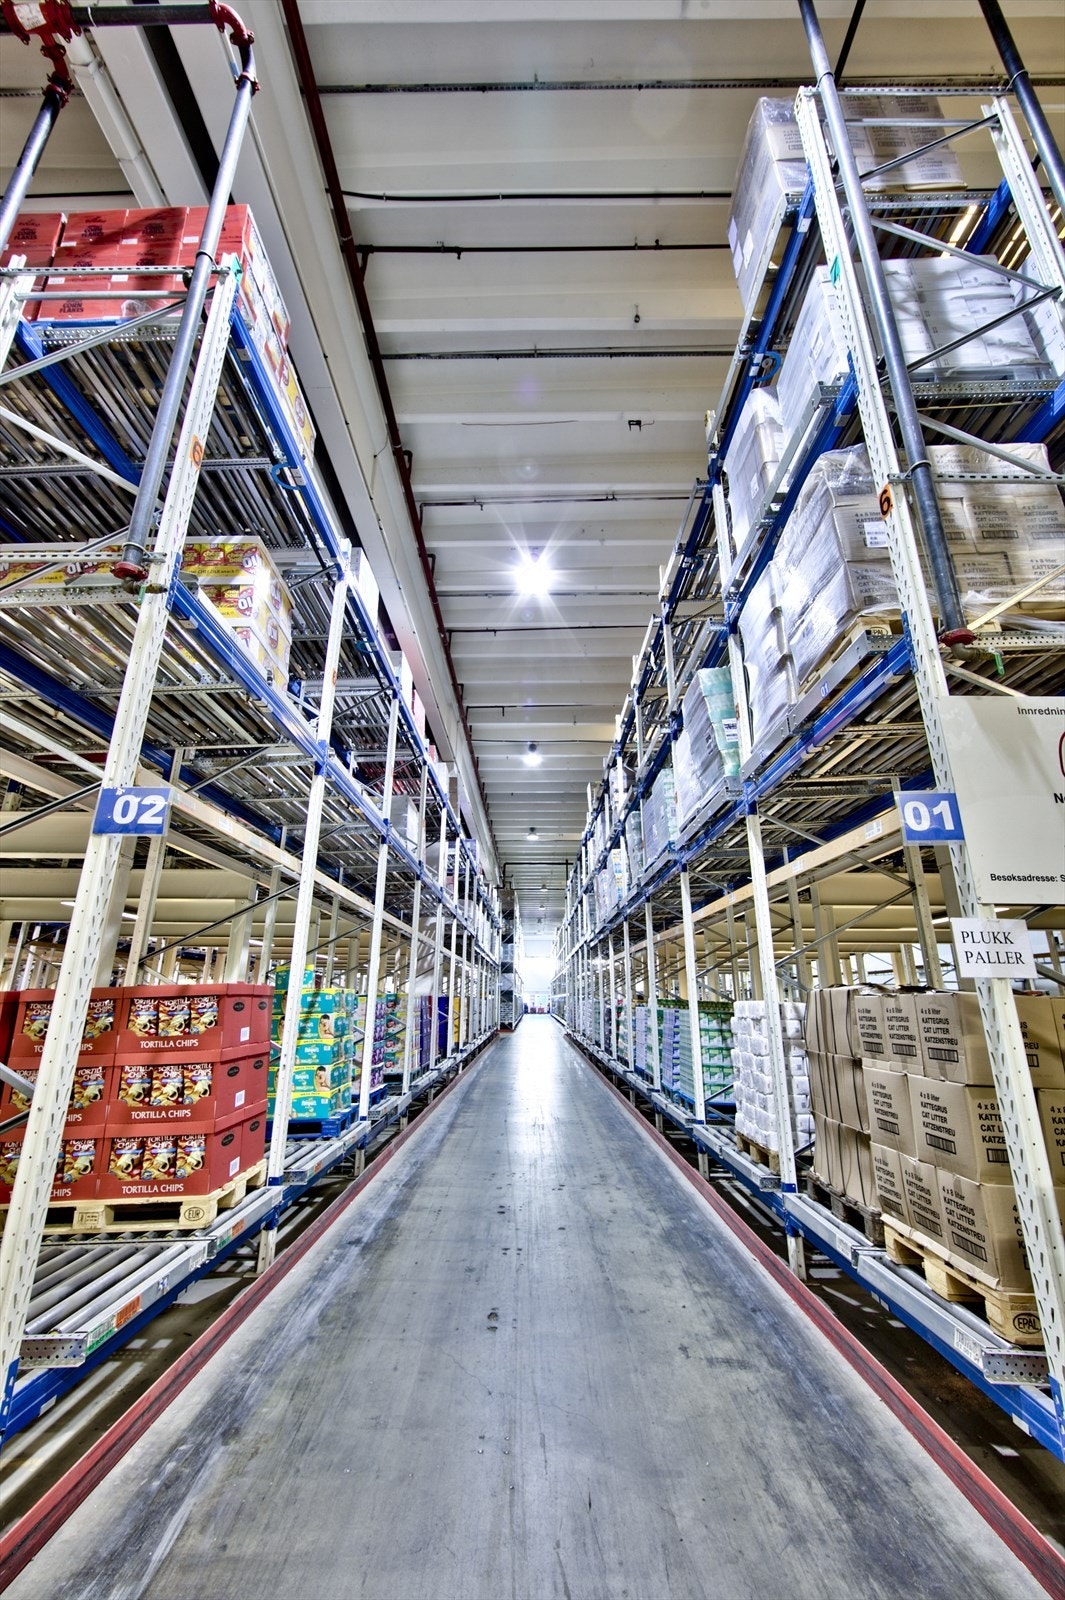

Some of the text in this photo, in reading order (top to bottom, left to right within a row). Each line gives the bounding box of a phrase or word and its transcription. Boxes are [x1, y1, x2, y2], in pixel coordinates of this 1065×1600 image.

[1054, 792, 1065, 804] N
[112, 794, 166, 825] 02
[904, 800, 955, 832] 01
[990, 874, 1058, 883] Besøksadresse:
[960, 930, 1015, 945] PLUKK
[964, 951, 1026, 966] PALLER
[140, 1039, 199, 1049] TORTILLA CHIPS
[924, 1037, 958, 1046] KATZENSTREU
[921, 1101, 948, 1114] KATTEGRUS
[66, 1114, 82, 1122] HIPS
[131, 1109, 191, 1119] TORTILLA CHIPS
[931, 1112, 948, 1124] LITTER
[922, 1121, 955, 1136] KATZENSTREU
[122, 1184, 184, 1194] TORTILLA CHIPS
[906, 1180, 931, 1196] KATTEGRUS
[916, 1194, 932, 1206] LITTER
[955, 1190, 965, 1201] liter
[944, 1196, 975, 1216] KATTEGRUS
[188, 1210, 200, 1219] EUR
[945, 1207, 976, 1227] CAT LITTER
[947, 1218, 985, 1242] KATZENSTREU
[1017, 1317, 1038, 1330] EPAL
